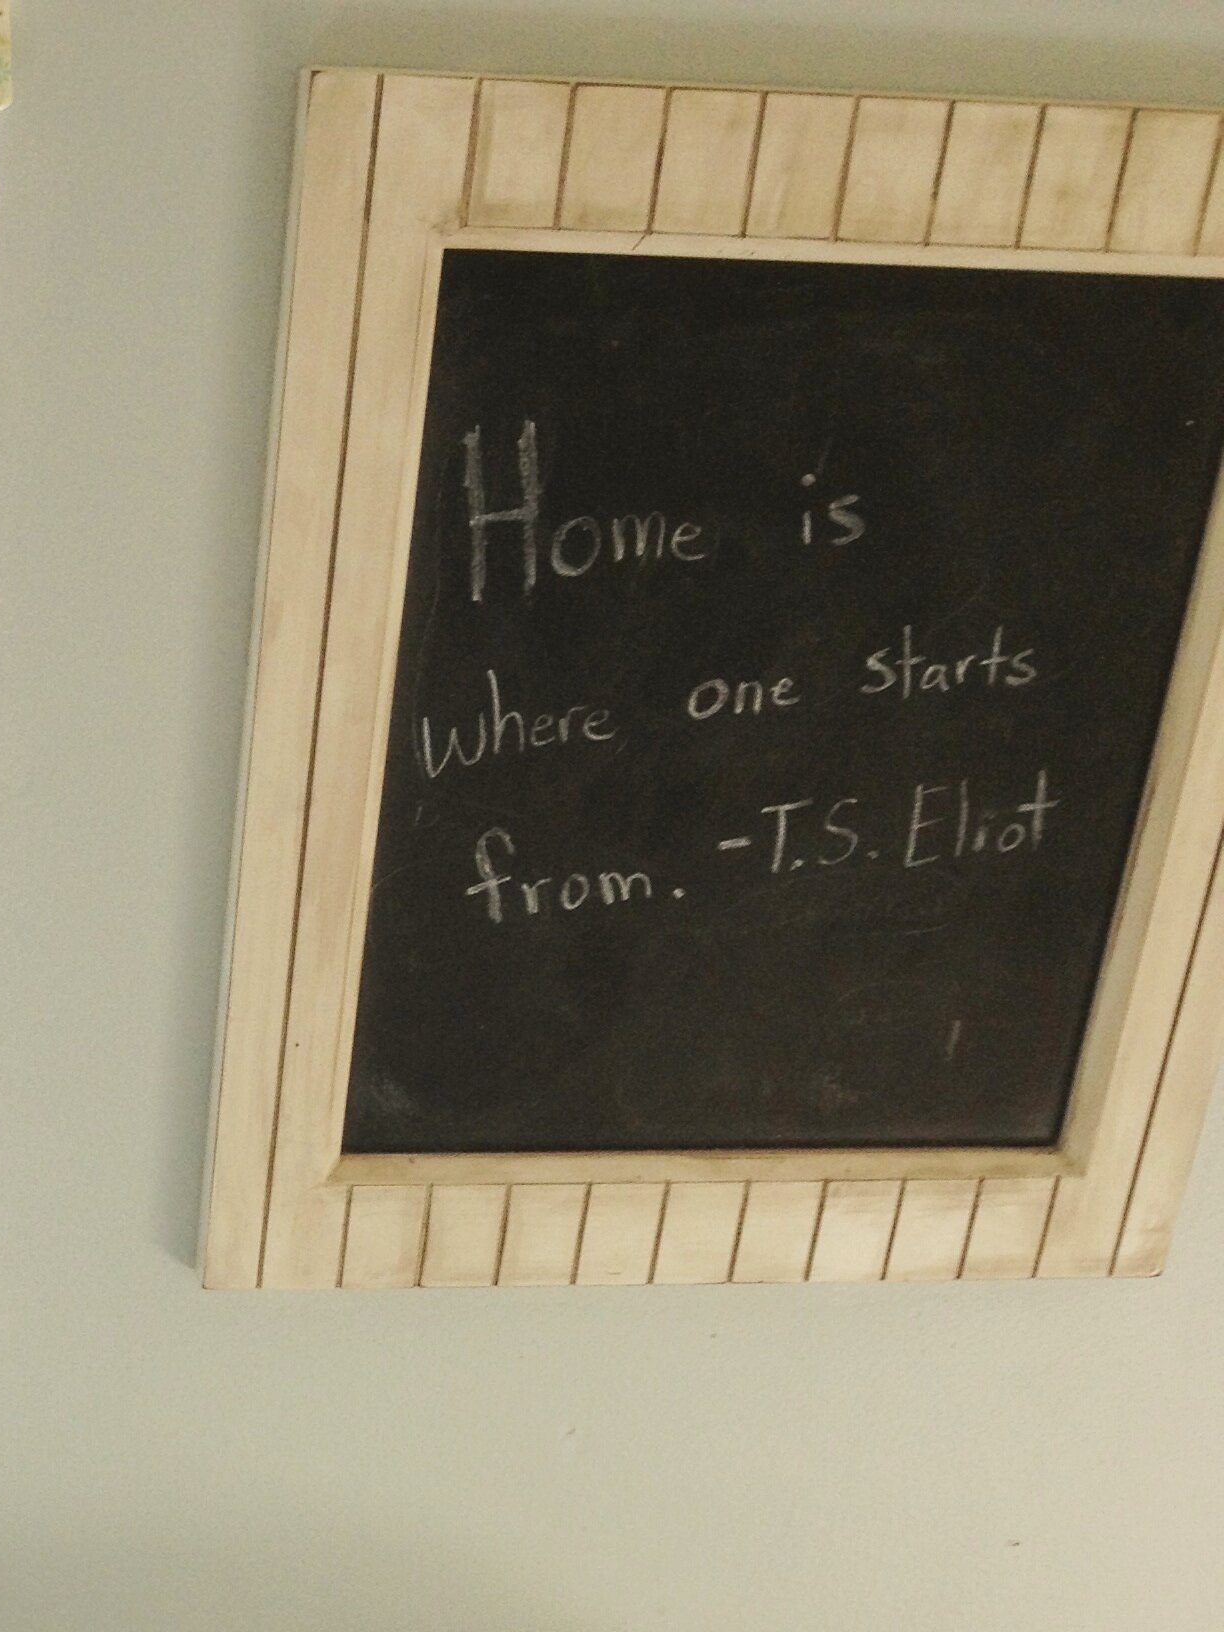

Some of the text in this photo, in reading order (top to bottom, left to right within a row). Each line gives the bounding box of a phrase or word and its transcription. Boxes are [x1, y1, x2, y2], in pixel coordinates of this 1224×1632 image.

[462, 420, 866, 602] Home is
[687, 678, 800, 719] one
[861, 624, 1037, 700] starts
[465, 827, 685, 923] from.
[905, 770, 1059, 868] Eliot
